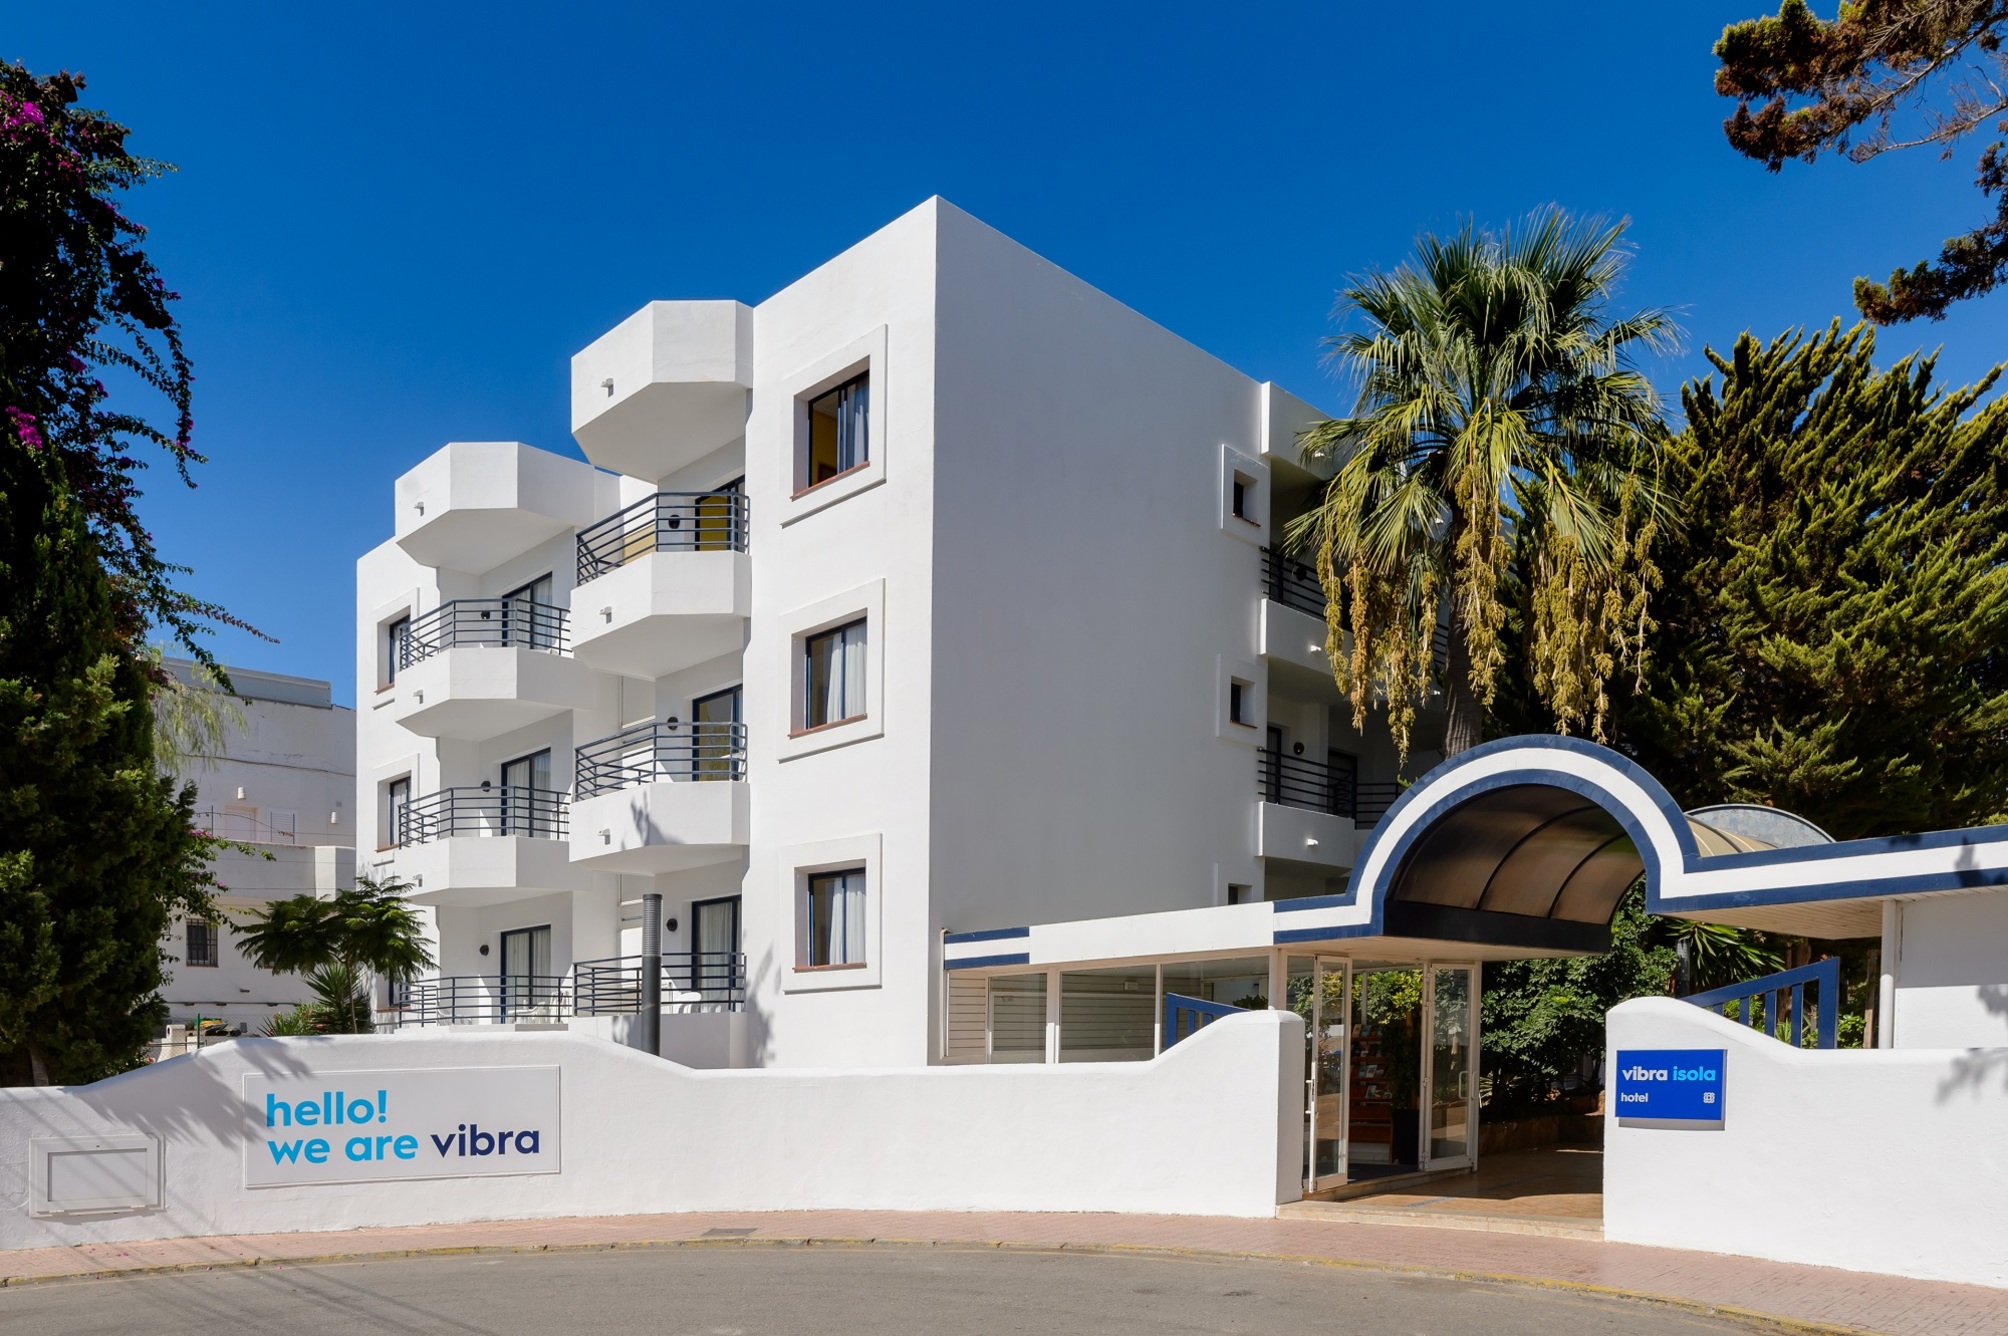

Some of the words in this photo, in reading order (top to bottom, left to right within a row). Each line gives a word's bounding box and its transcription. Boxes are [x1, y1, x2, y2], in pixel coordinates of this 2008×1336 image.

[1622, 1065, 1668, 1081] vibra
[1672, 1066, 1716, 1081] isola
[266, 1089, 387, 1127] hello!
[1620, 1092, 1649, 1103] hotel
[267, 1138, 330, 1166] we
[344, 1134, 419, 1161] are
[430, 1123, 540, 1158] vibra
